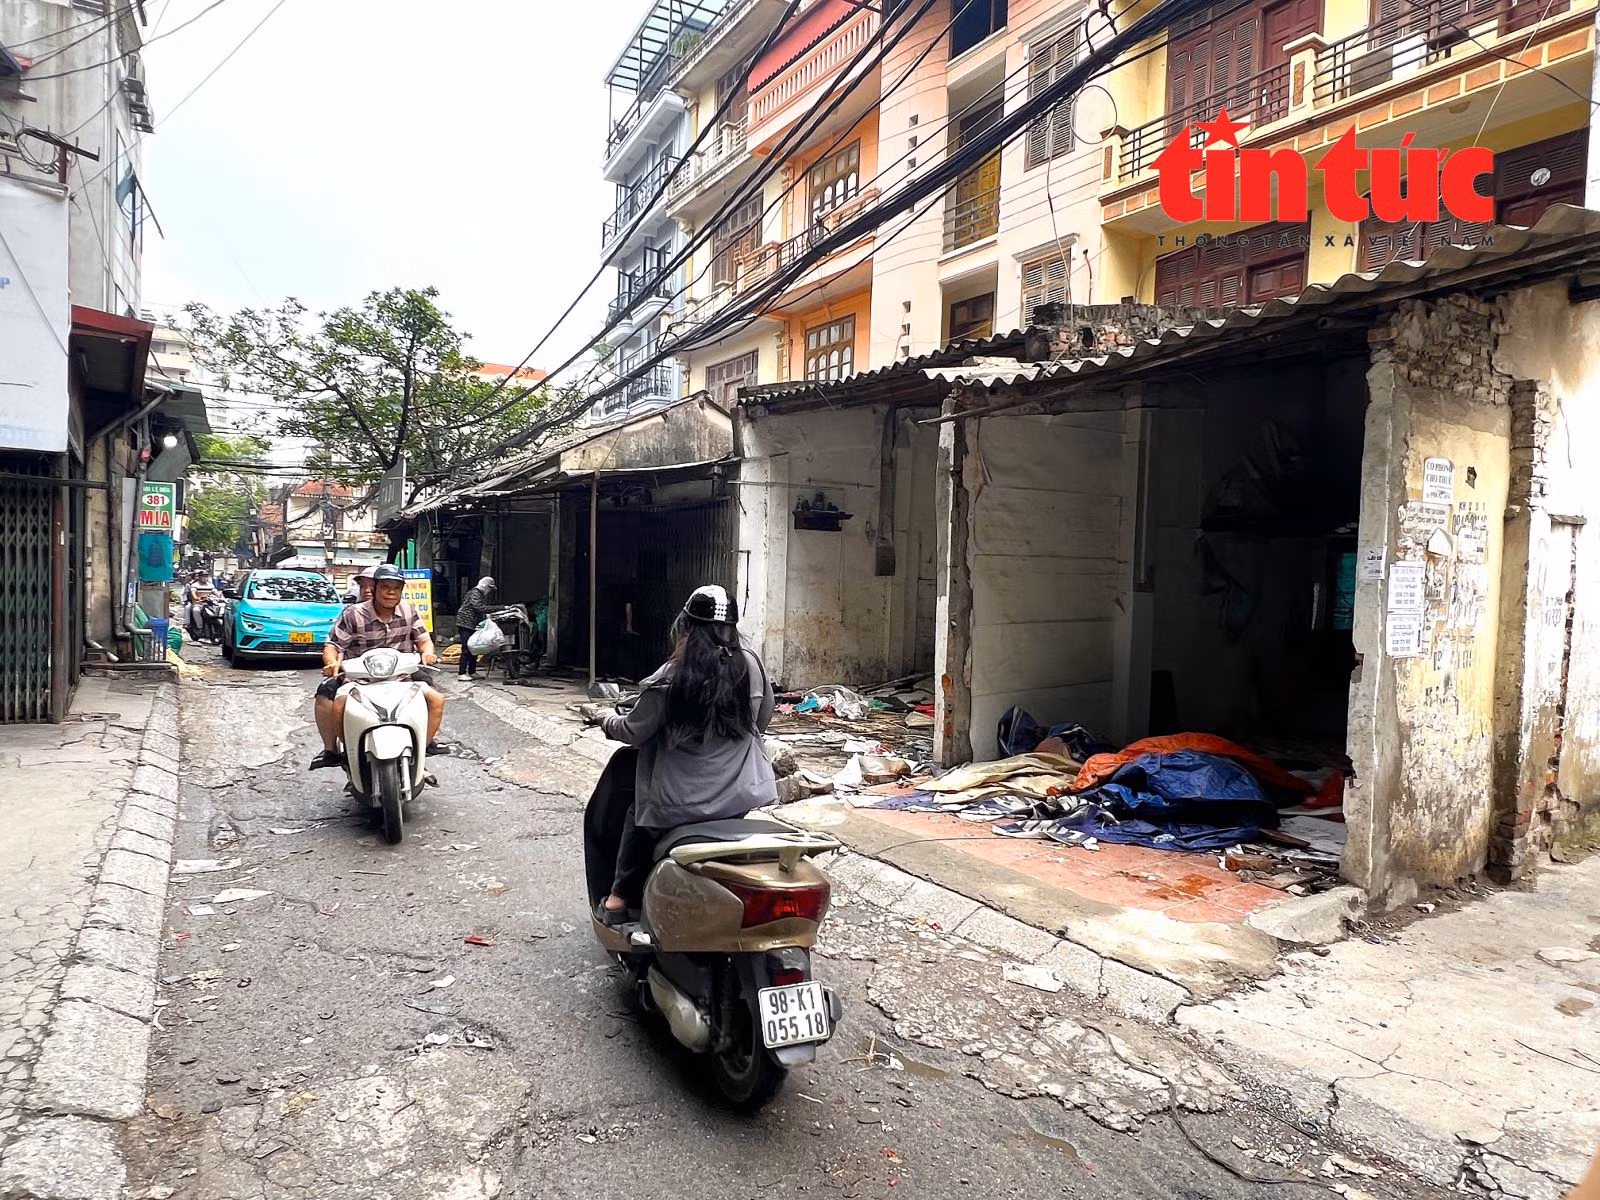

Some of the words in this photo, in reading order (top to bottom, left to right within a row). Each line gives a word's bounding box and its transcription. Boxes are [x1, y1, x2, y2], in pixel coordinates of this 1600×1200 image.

[146, 495, 165, 505] 381
[768, 986, 815, 1015] 98-K1
[767, 1012, 824, 1043] 055.18
